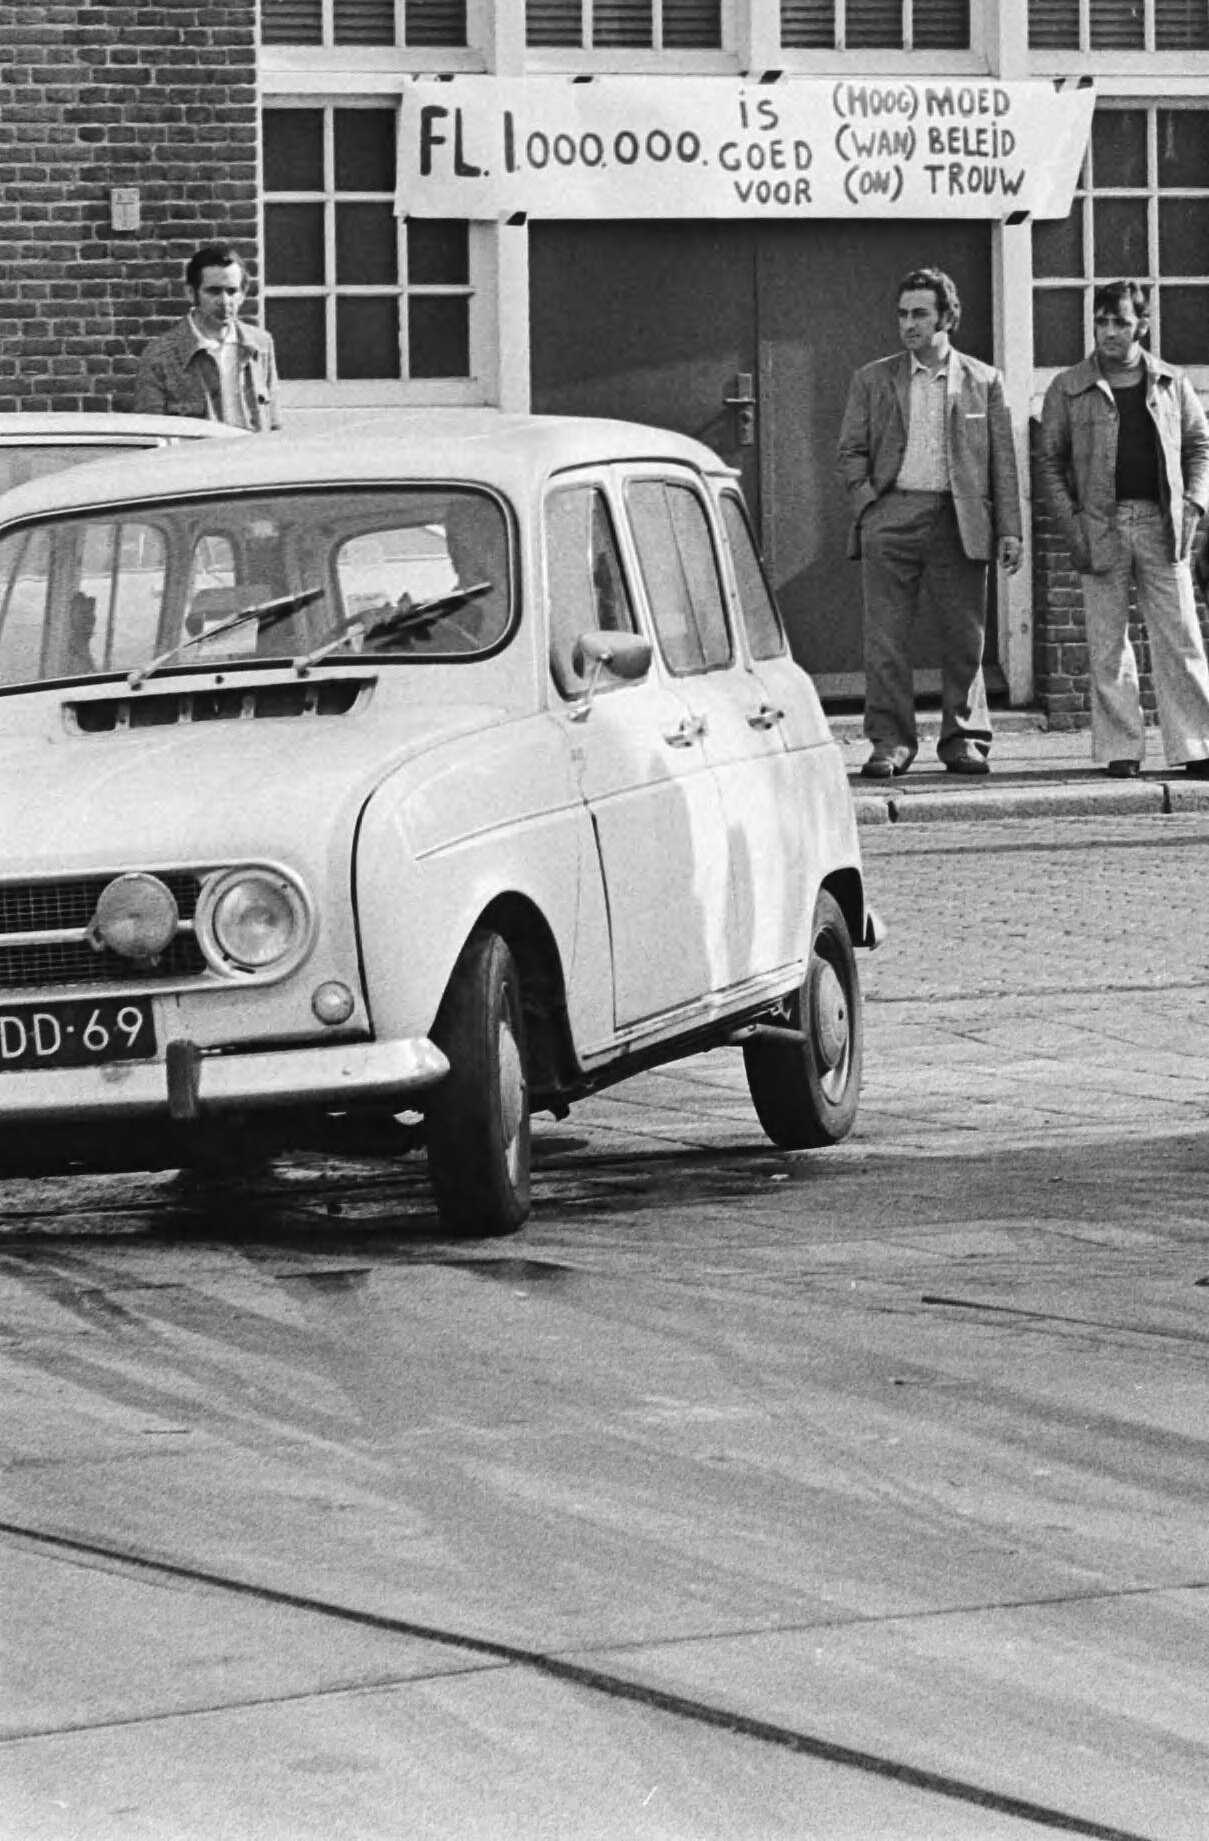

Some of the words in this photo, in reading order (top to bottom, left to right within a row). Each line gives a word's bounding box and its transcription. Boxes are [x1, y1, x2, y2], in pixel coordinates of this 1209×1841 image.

[420, 105, 490, 177] FL.
[719, 139, 813, 171] GOED
[734, 178, 812, 205] VOOR
[923, 162, 1026, 197] TROUW
